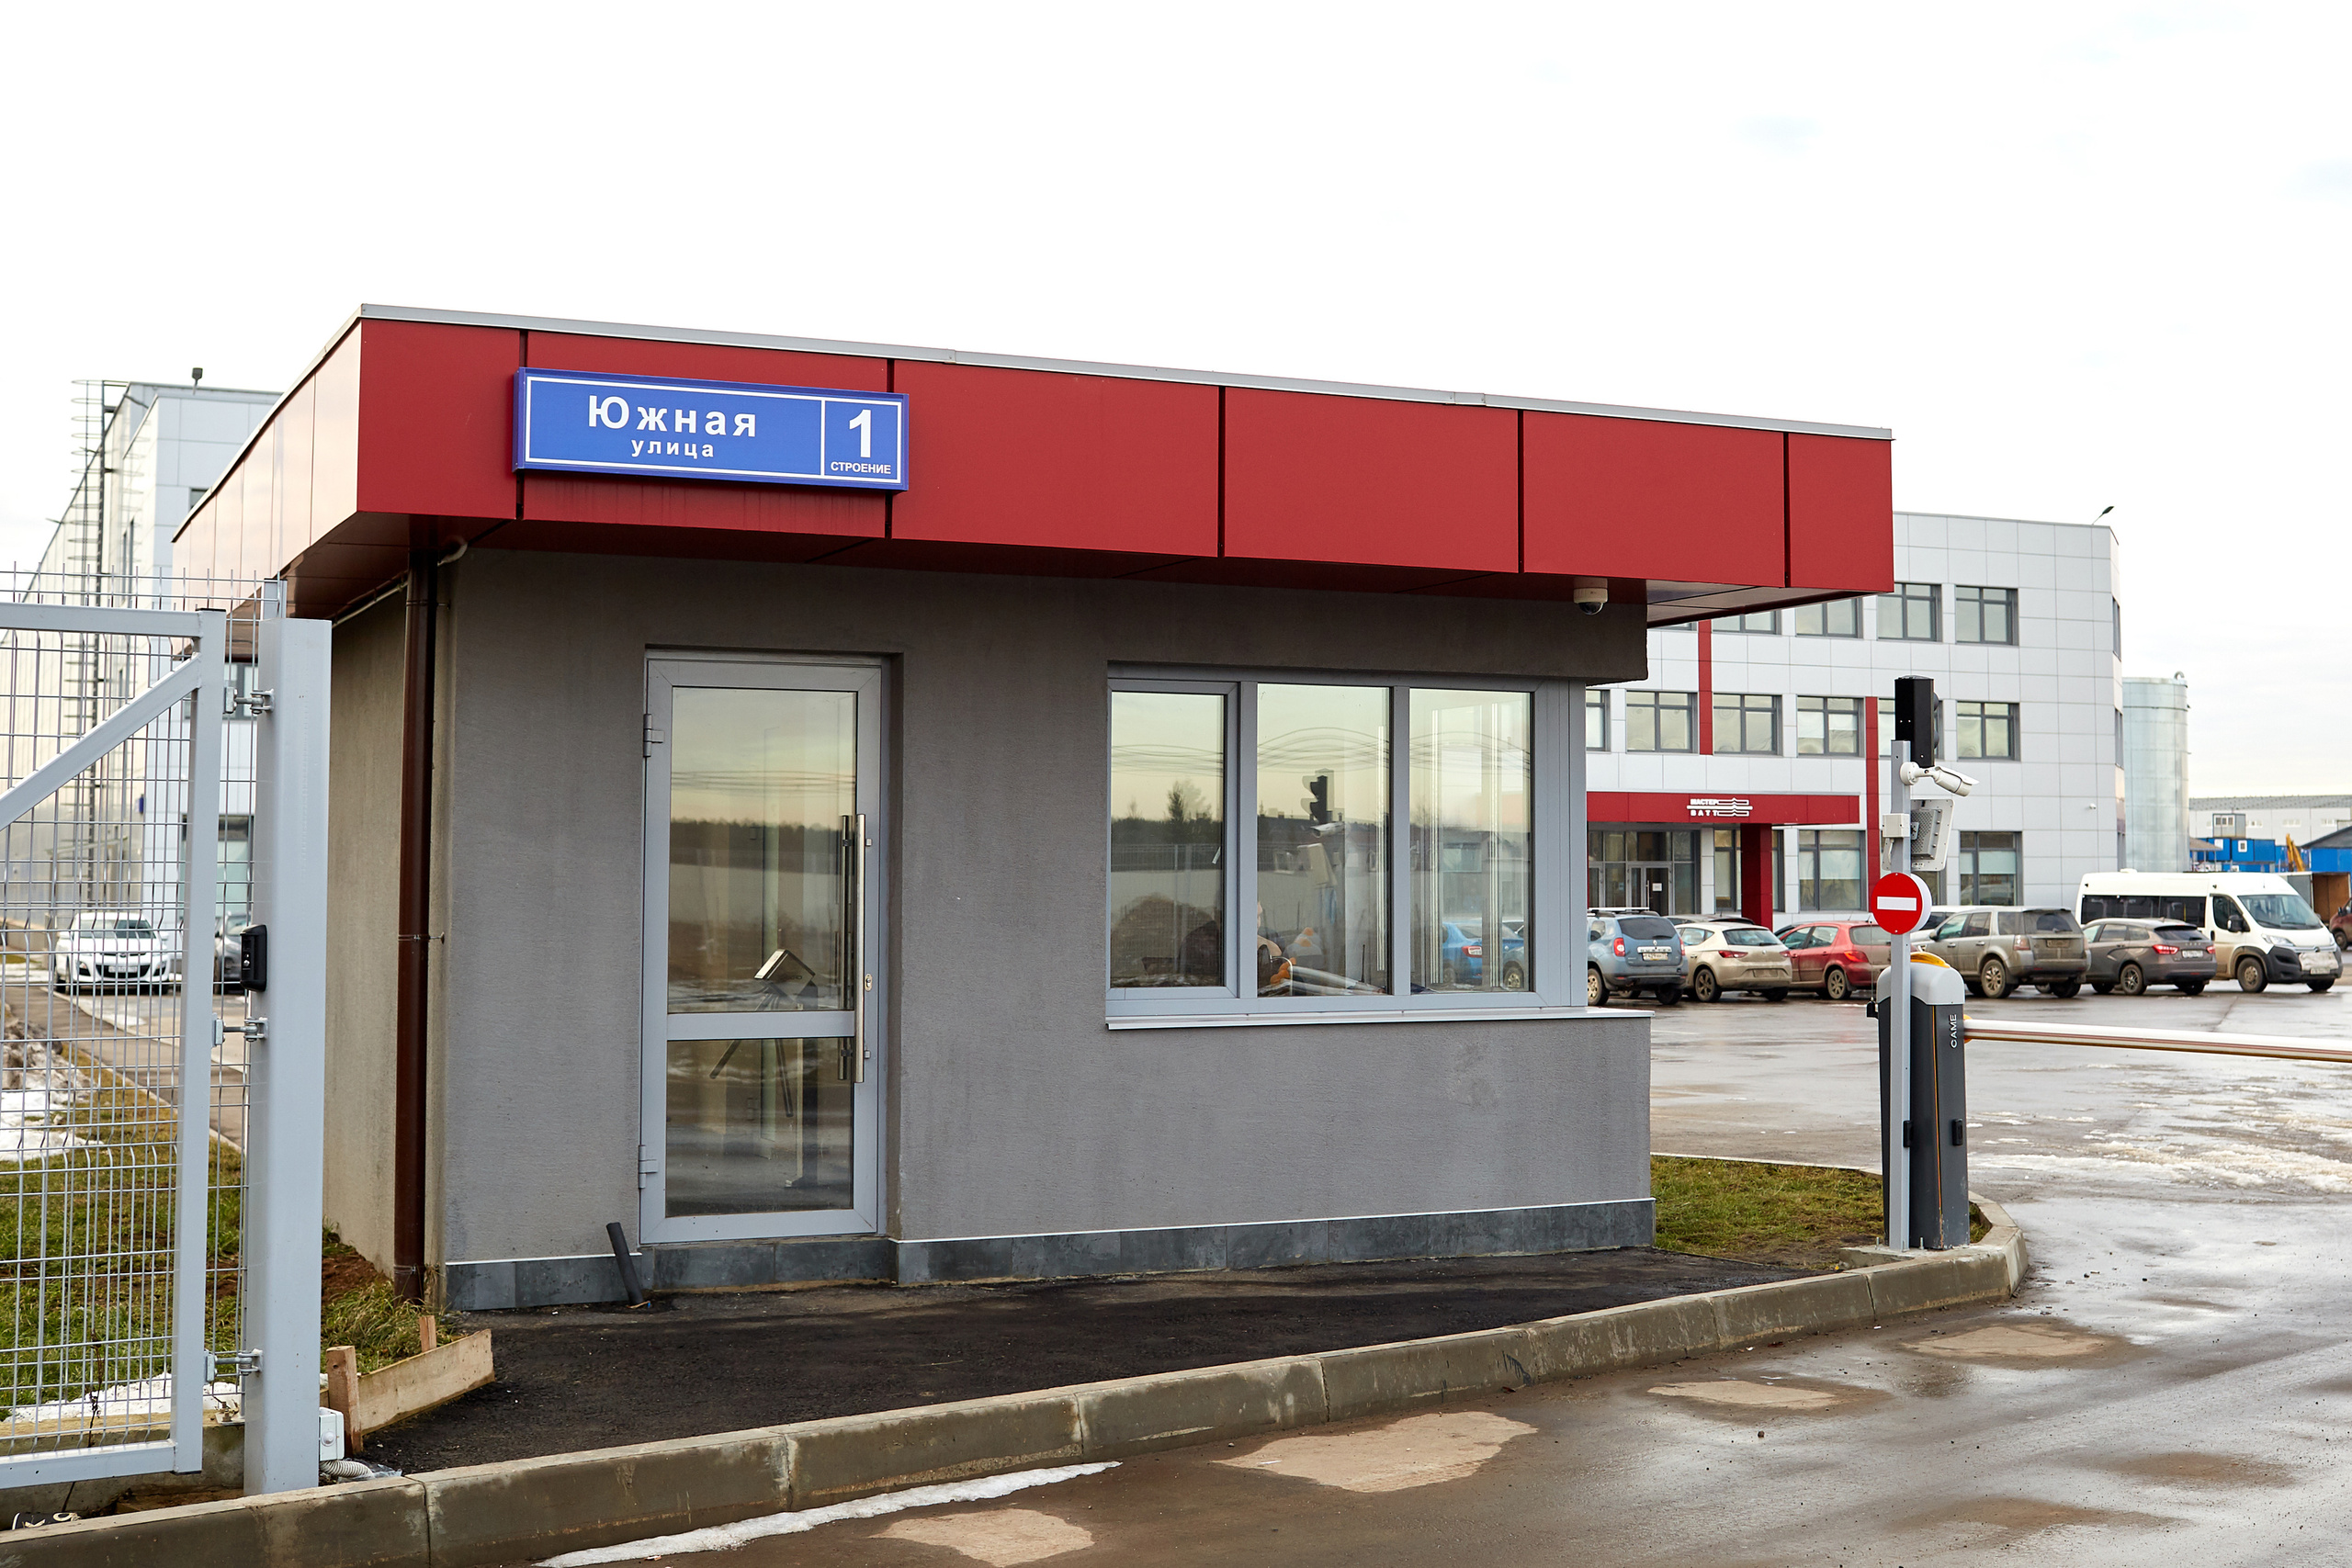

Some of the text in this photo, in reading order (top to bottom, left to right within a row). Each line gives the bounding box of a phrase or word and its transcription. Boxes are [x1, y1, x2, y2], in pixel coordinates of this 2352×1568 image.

[589, 395, 756, 436] Южная
[631, 439, 714, 458] улица
[849, 409, 872, 458] 1
[831, 461, 891, 474] СТРОЕНИЕ
[1950, 1014, 1958, 1048] CAME
